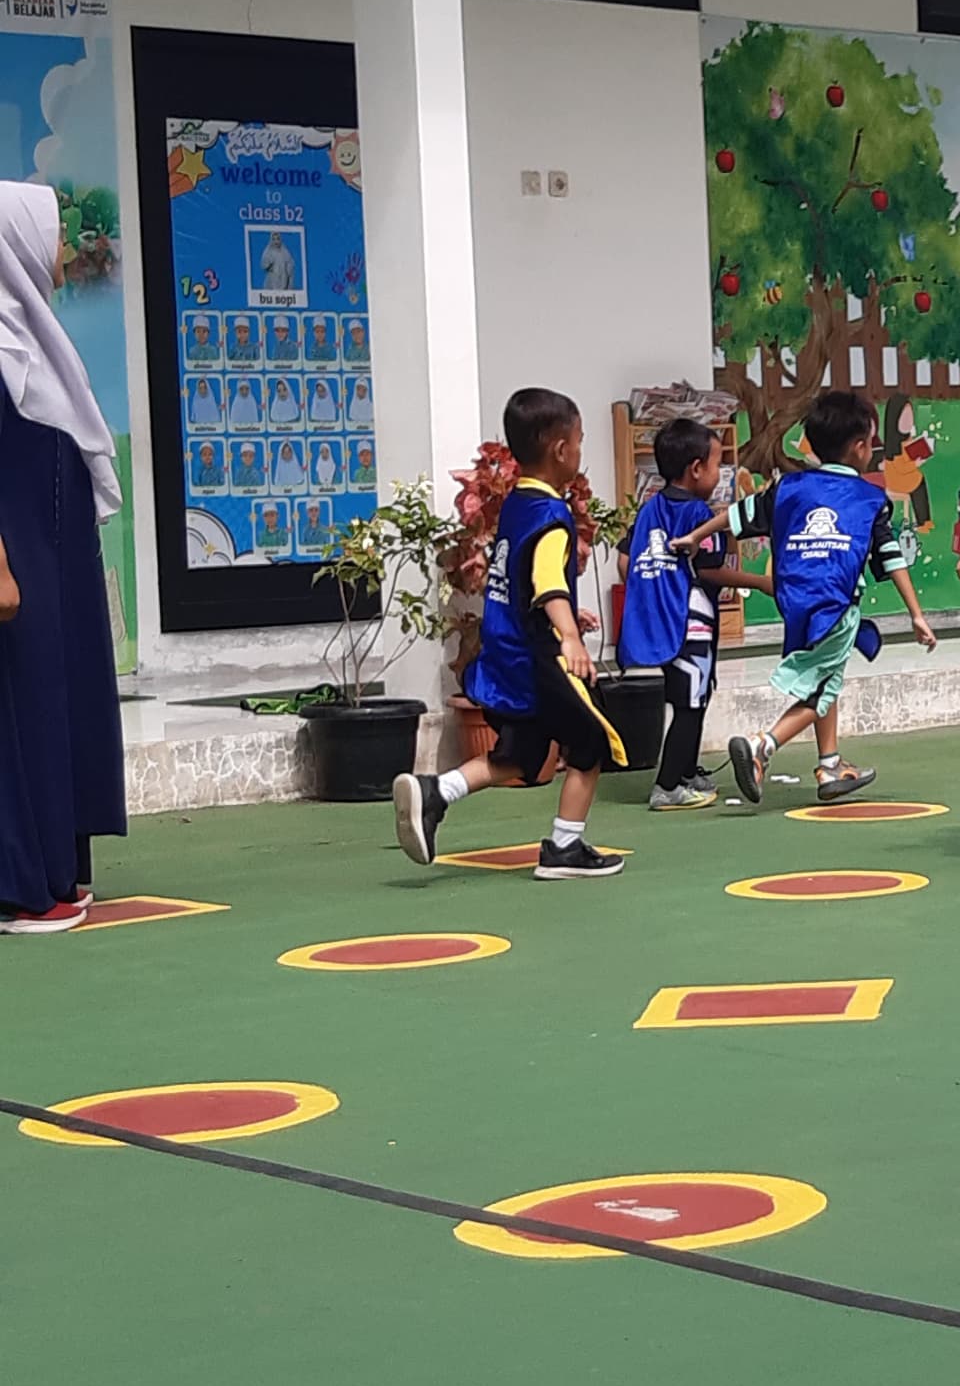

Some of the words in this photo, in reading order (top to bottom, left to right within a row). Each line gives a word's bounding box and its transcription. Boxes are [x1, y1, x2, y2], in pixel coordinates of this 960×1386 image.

[13, 4, 56, 18] BELAJAR
[221, 163, 322, 187] welcome
[266, 189, 282, 204] to
[239, 204, 281, 222] class
[285, 205, 304, 222] b2
[260, 294, 273, 305] bu
[275, 294, 297, 307] sopi
